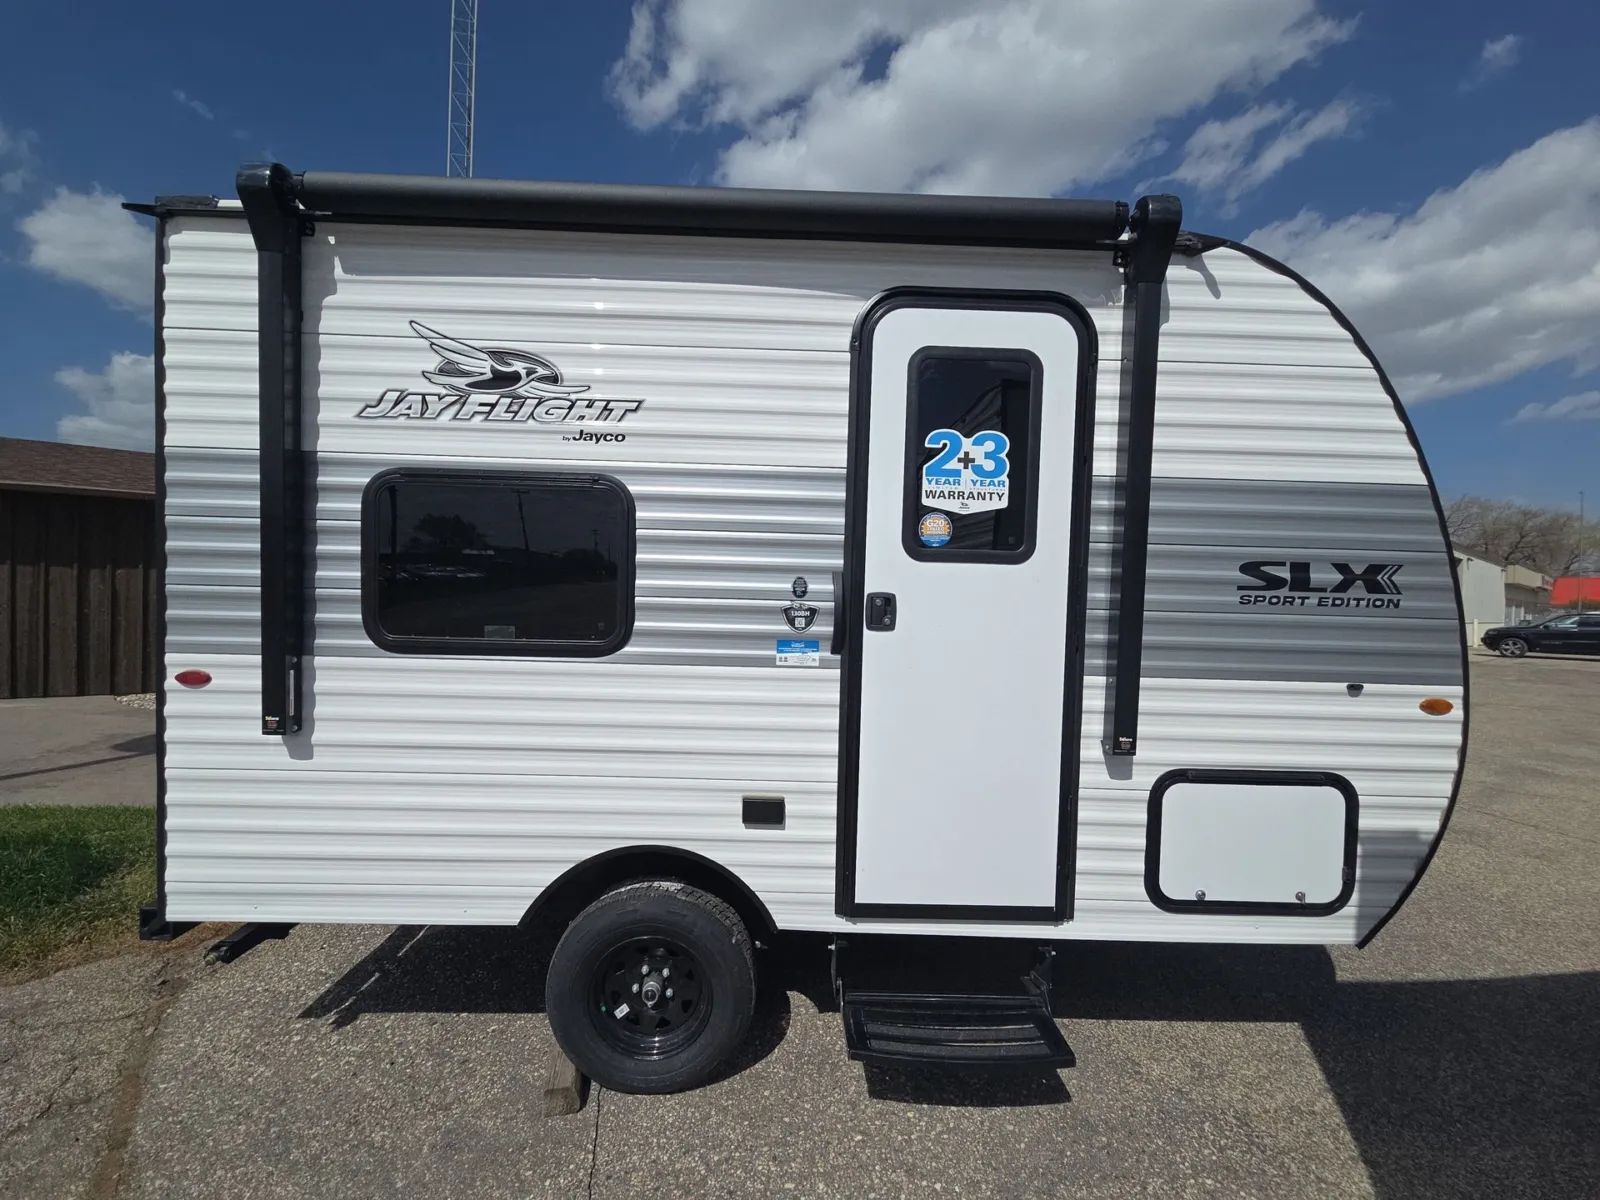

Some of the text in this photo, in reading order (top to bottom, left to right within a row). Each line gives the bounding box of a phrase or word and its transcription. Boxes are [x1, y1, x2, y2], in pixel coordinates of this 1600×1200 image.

[356, 389, 647, 424] JAY FLIGHT
[572, 429, 626, 444] Jayco
[926, 478, 1006, 488] YEAR YEAR
[925, 490, 1005, 501] WARRANTY
[1237, 561, 1404, 595] SLX
[1239, 594, 1401, 609] SPORT EDITION
